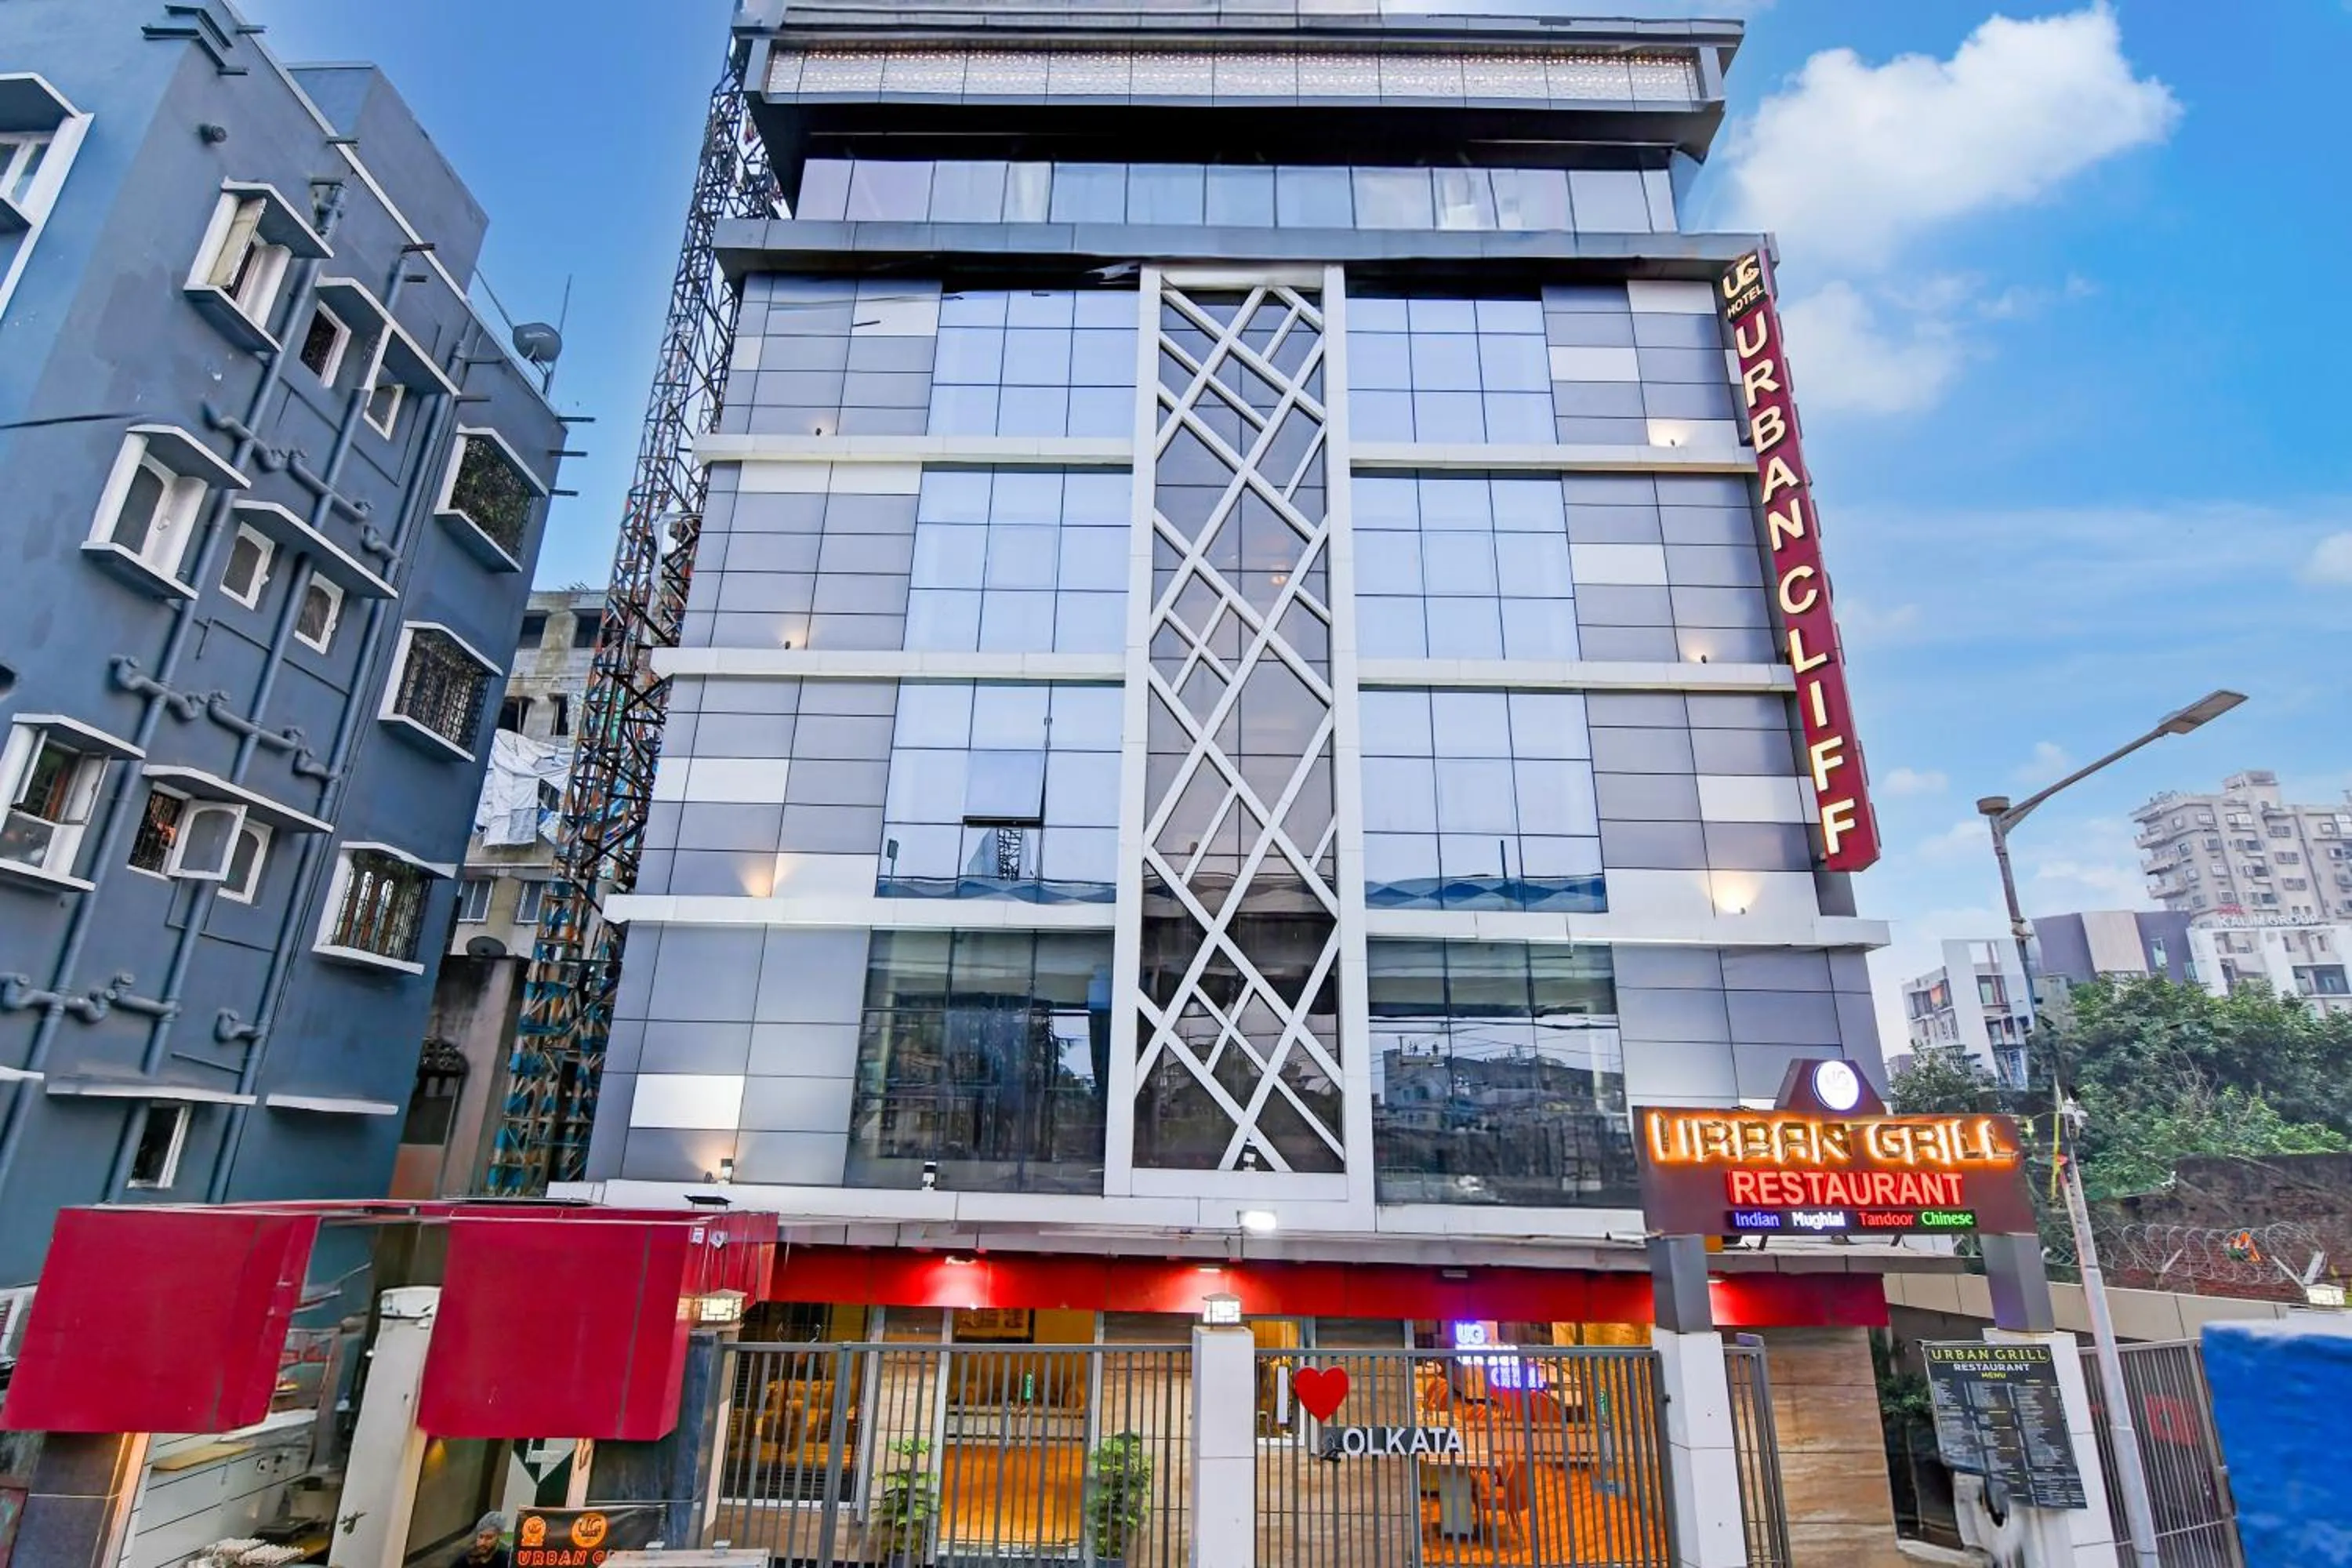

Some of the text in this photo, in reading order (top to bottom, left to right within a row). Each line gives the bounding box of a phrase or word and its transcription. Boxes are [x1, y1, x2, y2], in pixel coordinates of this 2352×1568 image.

[1727, 284, 1766, 318] HOTEL
[1735, 310, 1856, 855] URBAN CLIFF
[2268, 914, 2319, 926] GROUP
[1649, 1110, 2019, 1165] URBAN GRILL
[1730, 1170, 1963, 1206] RESTAURANT
[1734, 1212, 1780, 1227] Indian
[1858, 1212, 1913, 1227] Tandoor
[1922, 1211, 1974, 1225] Chinese
[1932, 1349, 2047, 1360] URBAN GRILL
[517, 1549, 588, 1566] URBAN
